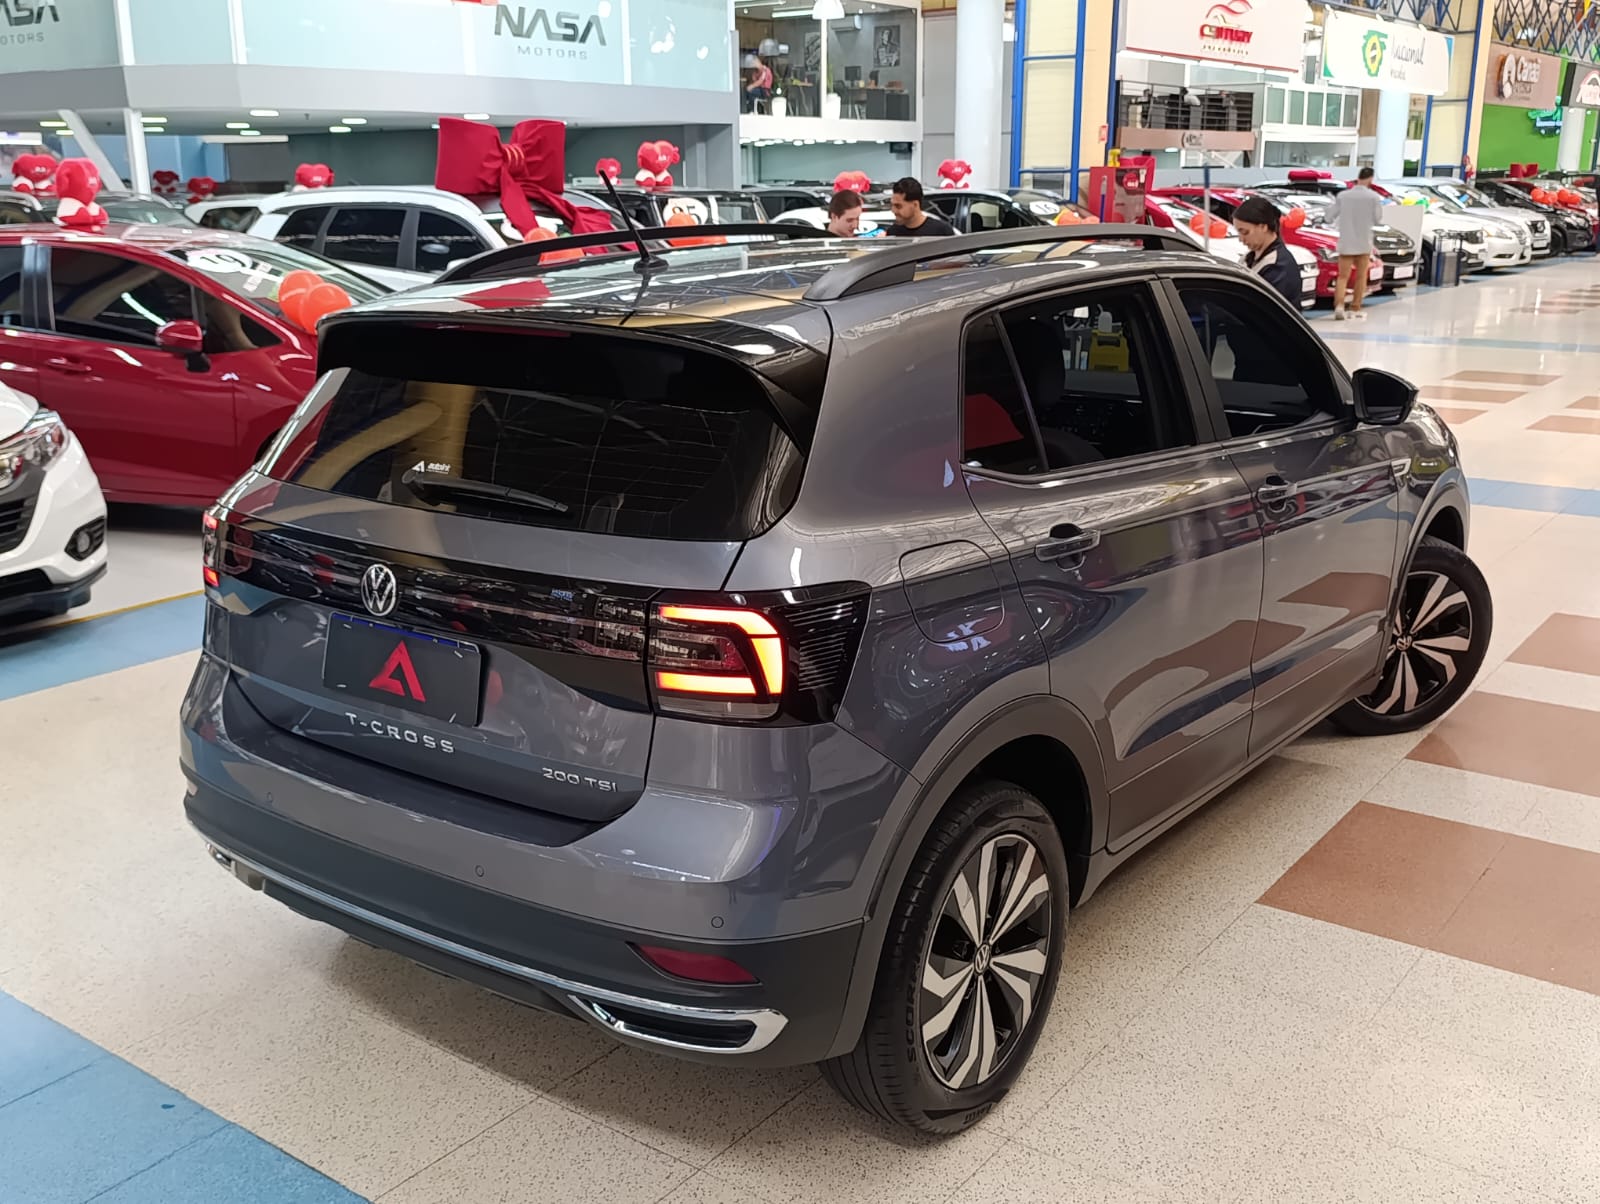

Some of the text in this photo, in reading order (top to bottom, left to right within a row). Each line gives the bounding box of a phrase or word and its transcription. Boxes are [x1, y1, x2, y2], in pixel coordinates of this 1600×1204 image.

[494, 4, 607, 46] NASA
[517, 45, 588, 60] MOTORS
[344, 712, 456, 754] T-CROSS
[541, 767, 618, 793] 200 TSI
